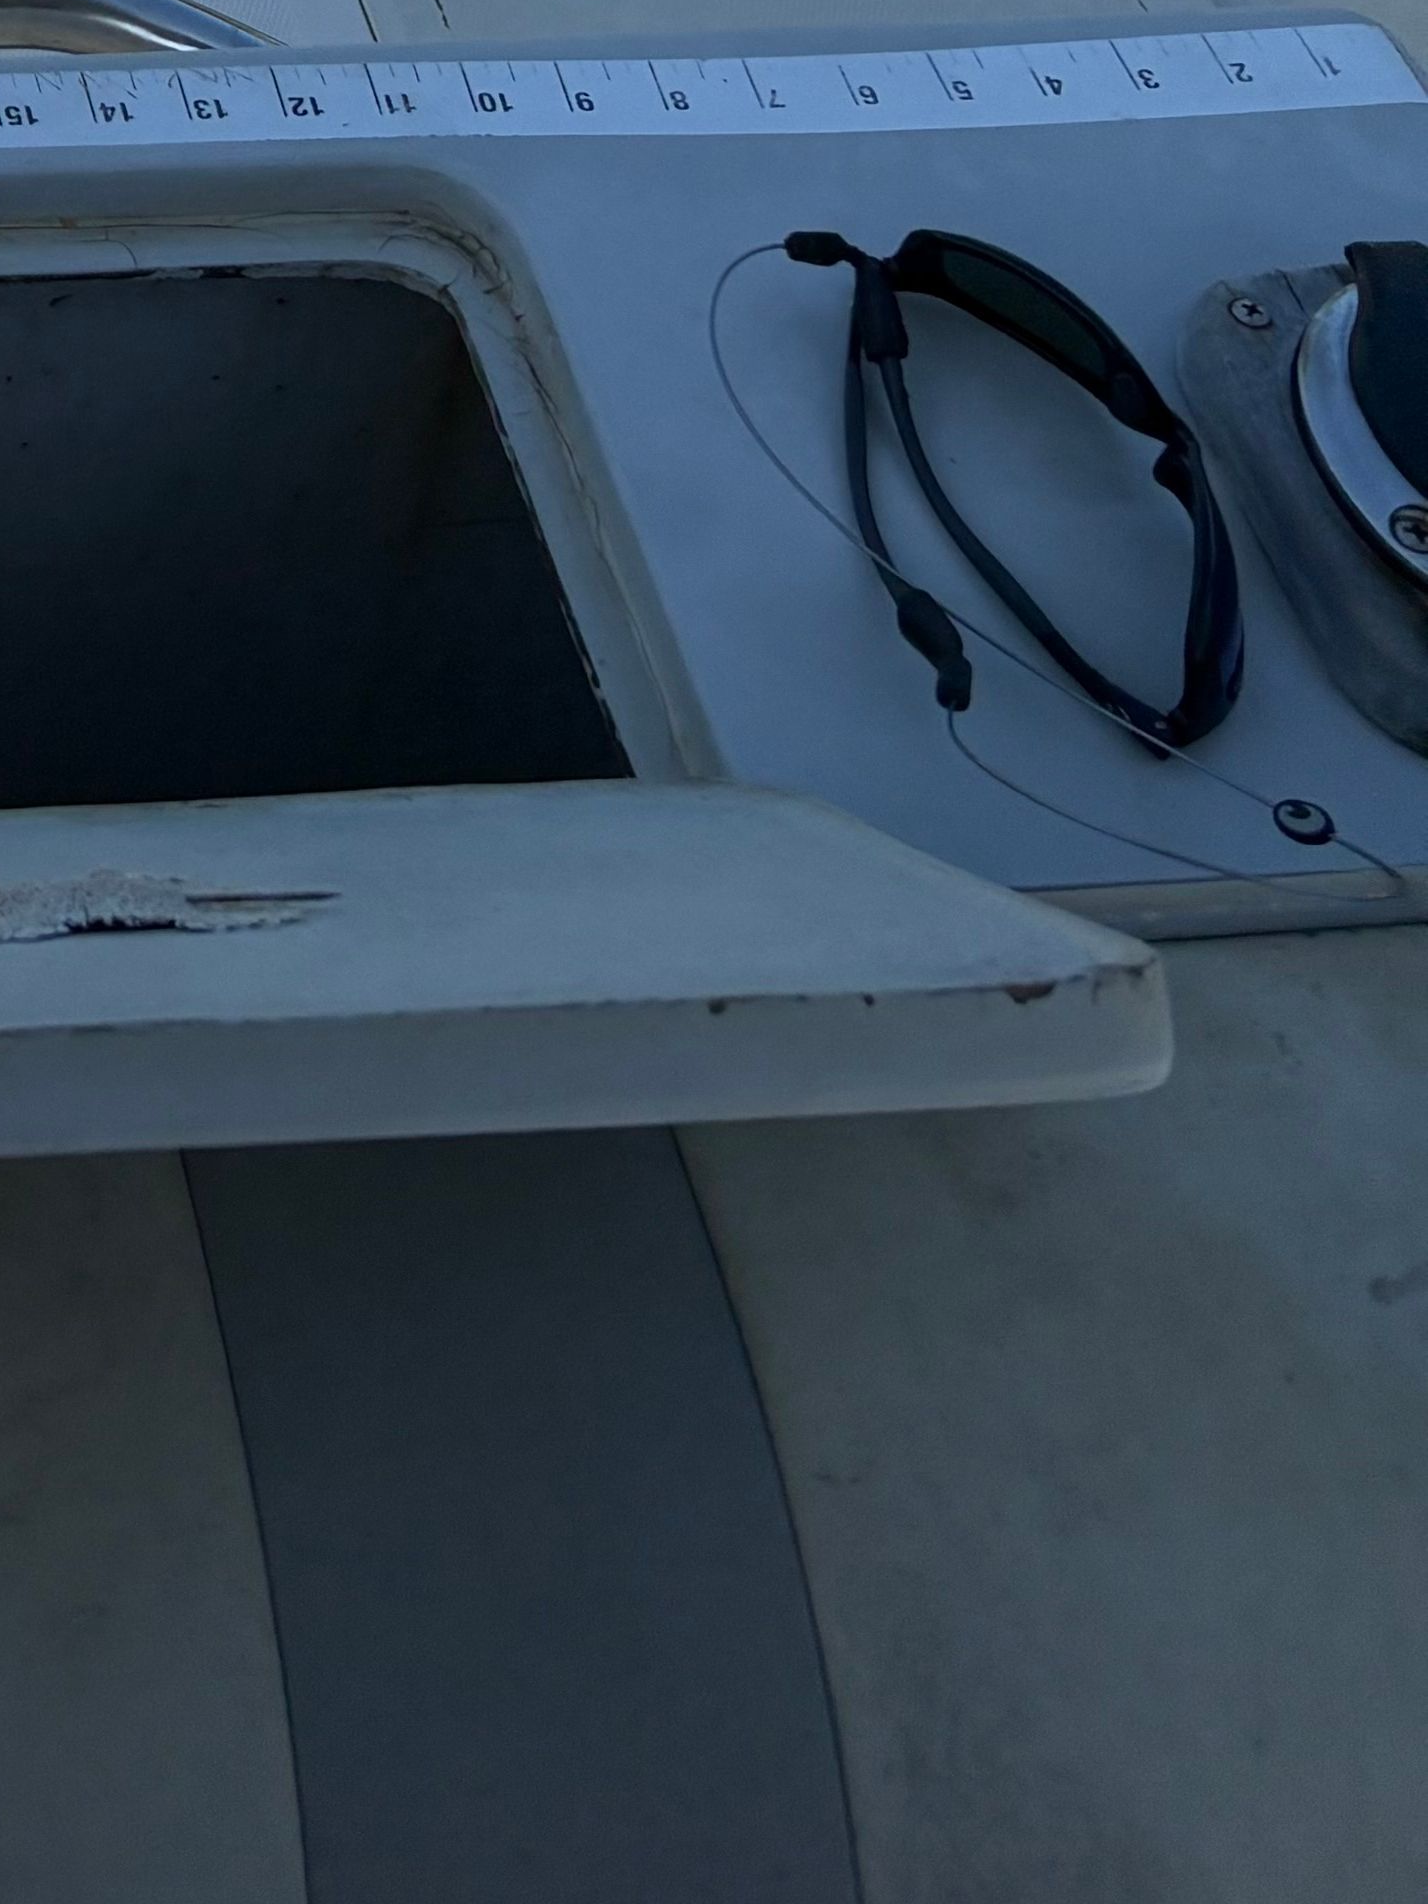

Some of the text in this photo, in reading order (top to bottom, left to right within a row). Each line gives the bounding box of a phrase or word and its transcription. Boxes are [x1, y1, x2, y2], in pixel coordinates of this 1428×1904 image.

[1228, 62, 1254, 83] 2
[1323, 56, 1342, 77] 1
[1044, 75, 1063, 96] 4
[1137, 68, 1160, 89] 3
[669, 90, 690, 111] 8
[769, 88, 787, 109] 7
[858, 85, 879, 105] 6
[951, 80, 974, 101] 5
[193, 99, 229, 120] 13
[287, 96, 325, 117] 12
[384, 93, 417, 115] 11
[478, 92, 514, 113] 10
[574, 91, 595, 112] 9
[4, 105, 39, 126] 15
[99, 102, 135, 123] 14
